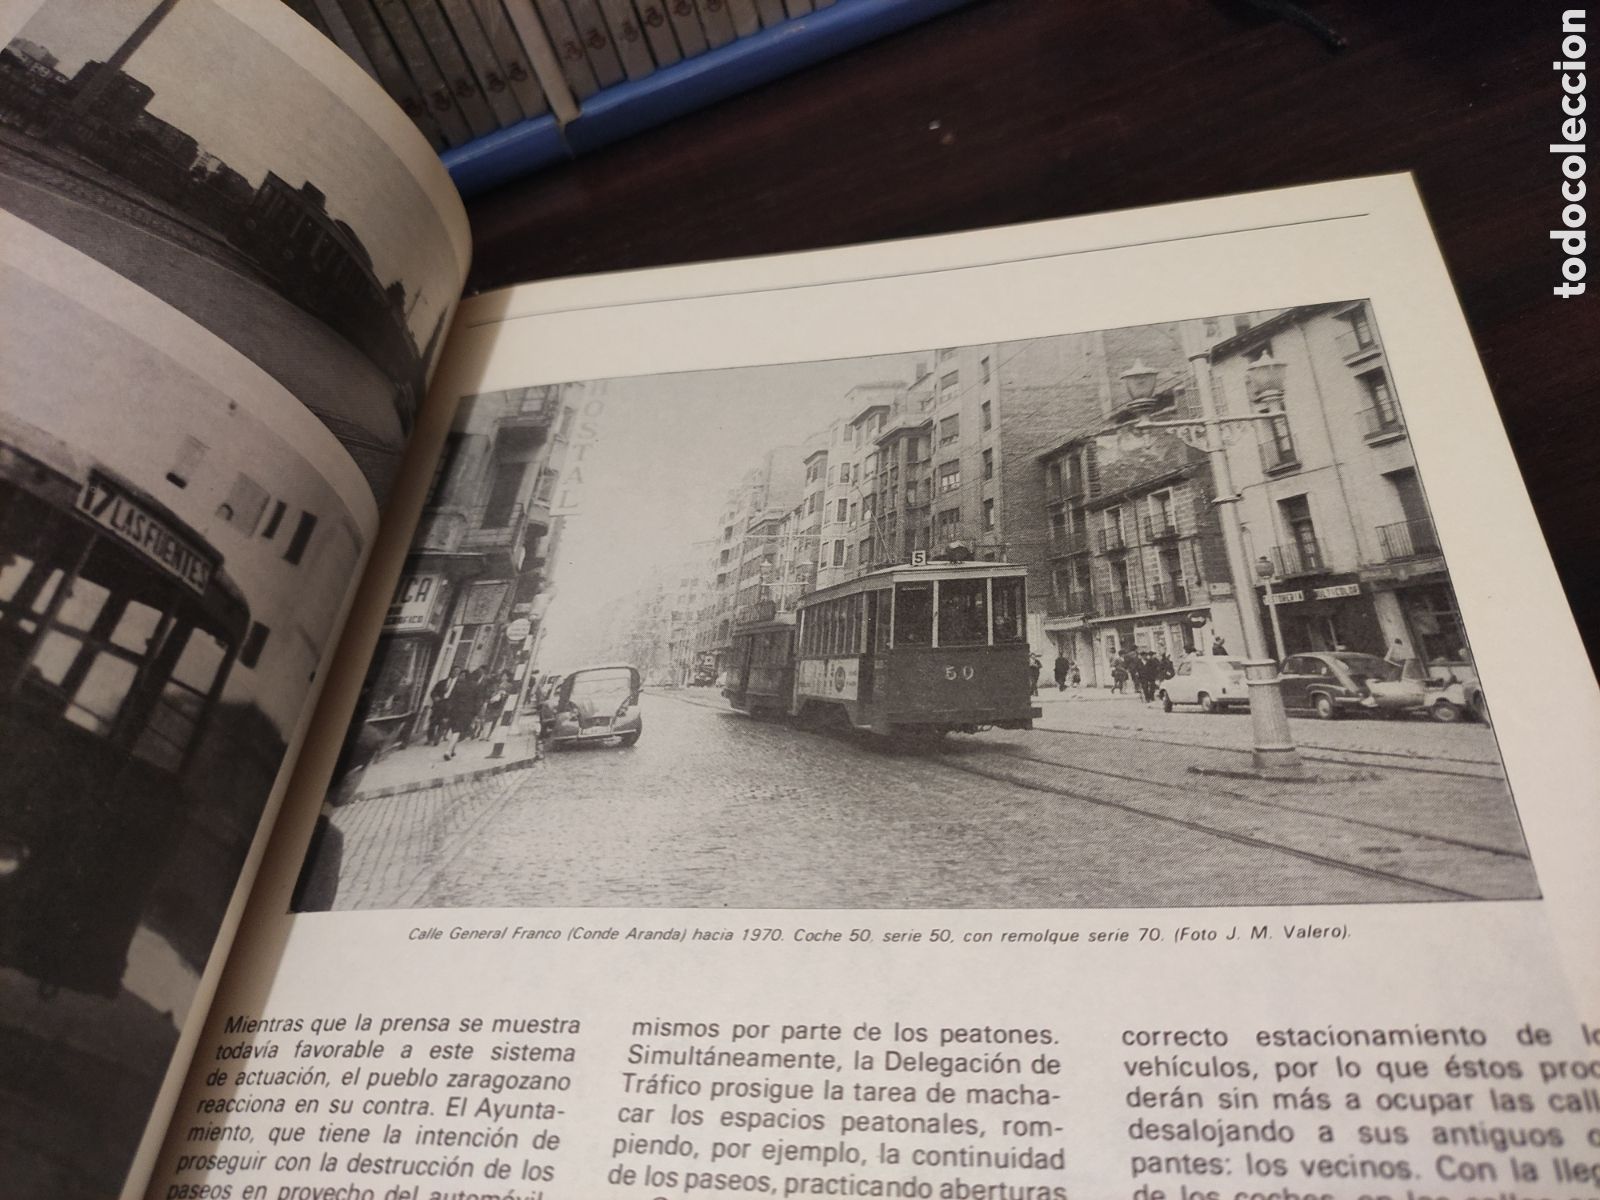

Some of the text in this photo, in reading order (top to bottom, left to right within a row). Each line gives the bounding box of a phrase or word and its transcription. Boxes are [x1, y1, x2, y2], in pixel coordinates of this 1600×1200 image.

[110, 499, 146, 541] LAS
[914, 552, 924, 564] 5
[945, 665, 974, 681] 50
[409, 928, 442, 940] Calle
[449, 927, 507, 940] General
[512, 927, 561, 940] Franco
[567, 927, 619, 941] (Conde
[625, 927, 686, 942] Aranda)
[692, 928, 733, 941] hacia
[742, 928, 784, 941] 1970.
[794, 928, 842, 942] Coche
[883, 929, 921, 942] serie
[929, 929, 954, 944] 50,
[963, 931, 992, 942] con
[1000, 929, 1079, 944] remolque
[1088, 929, 1129, 942] serie
[1139, 928, 1164, 941] 70.
[1174, 927, 1217, 942] (Foto
[1226, 926, 1240, 940] J.
[1250, 926, 1273, 940] M.
[1284, 924, 1351, 941] Valero).
[224, 1014, 581, 1035] Mientras que la prensa se muestra
[631, 1017, 1059, 1047] mismos por parte de los peatones.
[1122, 1029, 1228, 1047] correcto
[1256, 1024, 1487, 1047] estacionamiento
[1516, 1023, 1552, 1046] de
[215, 1040, 576, 1062] todavía favorable a este sistema
[628, 1043, 1061, 1077] Simultáneamente, la Delegación de
[206, 1065, 571, 1094] de actuación, el pueblo zaragozano
[1123, 1055, 1258, 1080] vehículos,
[1275, 1060, 1318, 1082] por
[1336, 1055, 1361, 1078] lo
[1376, 1060, 1429, 1083] que
[1444, 1054, 1523, 1079] éstos
[622, 1072, 1061, 1105] Tráfico prosigue la tarea de macha-
[1126, 1086, 1203, 1109] derán
[1218, 1087, 1258, 1109] sin
[1273, 1087, 1331, 1110] más
[1345, 1092, 1360, 1110] a
[1376, 1092, 1474, 1116] ocupar
[1490, 1088, 1535, 1113] las
[196, 1094, 565, 1122] reacciona en su contra. El Ayunta-
[617, 1104, 1063, 1138] car los espacios peatonales, rom-
[187, 1122, 560, 1150] miento, que tiene la intención de
[1128, 1117, 1295, 1147] desalojando
[1318, 1125, 1334, 1143] a
[1358, 1126, 1409, 1145] sus
[1432, 1121, 1565, 1152] antiguos
[176, 1150, 555, 1181] proseguir con la destrucción de los
[612, 1132, 1065, 1170] piendo, por ejemplo, la continuidad
[607, 1163, 1067, 1200] de los paseos, practicando aberturas
[1131, 1154, 1232, 1178] pantes:
[1246, 1152, 1288, 1177] los
[1300, 1154, 1422, 1180] vecinos.
[1435, 1154, 1498, 1182] Con
[1510, 1156, 1539, 1182] la
[167, 1183, 232, 1200] paseos
[242, 1184, 268, 1200] en
[277, 1183, 374, 1200] provecho
